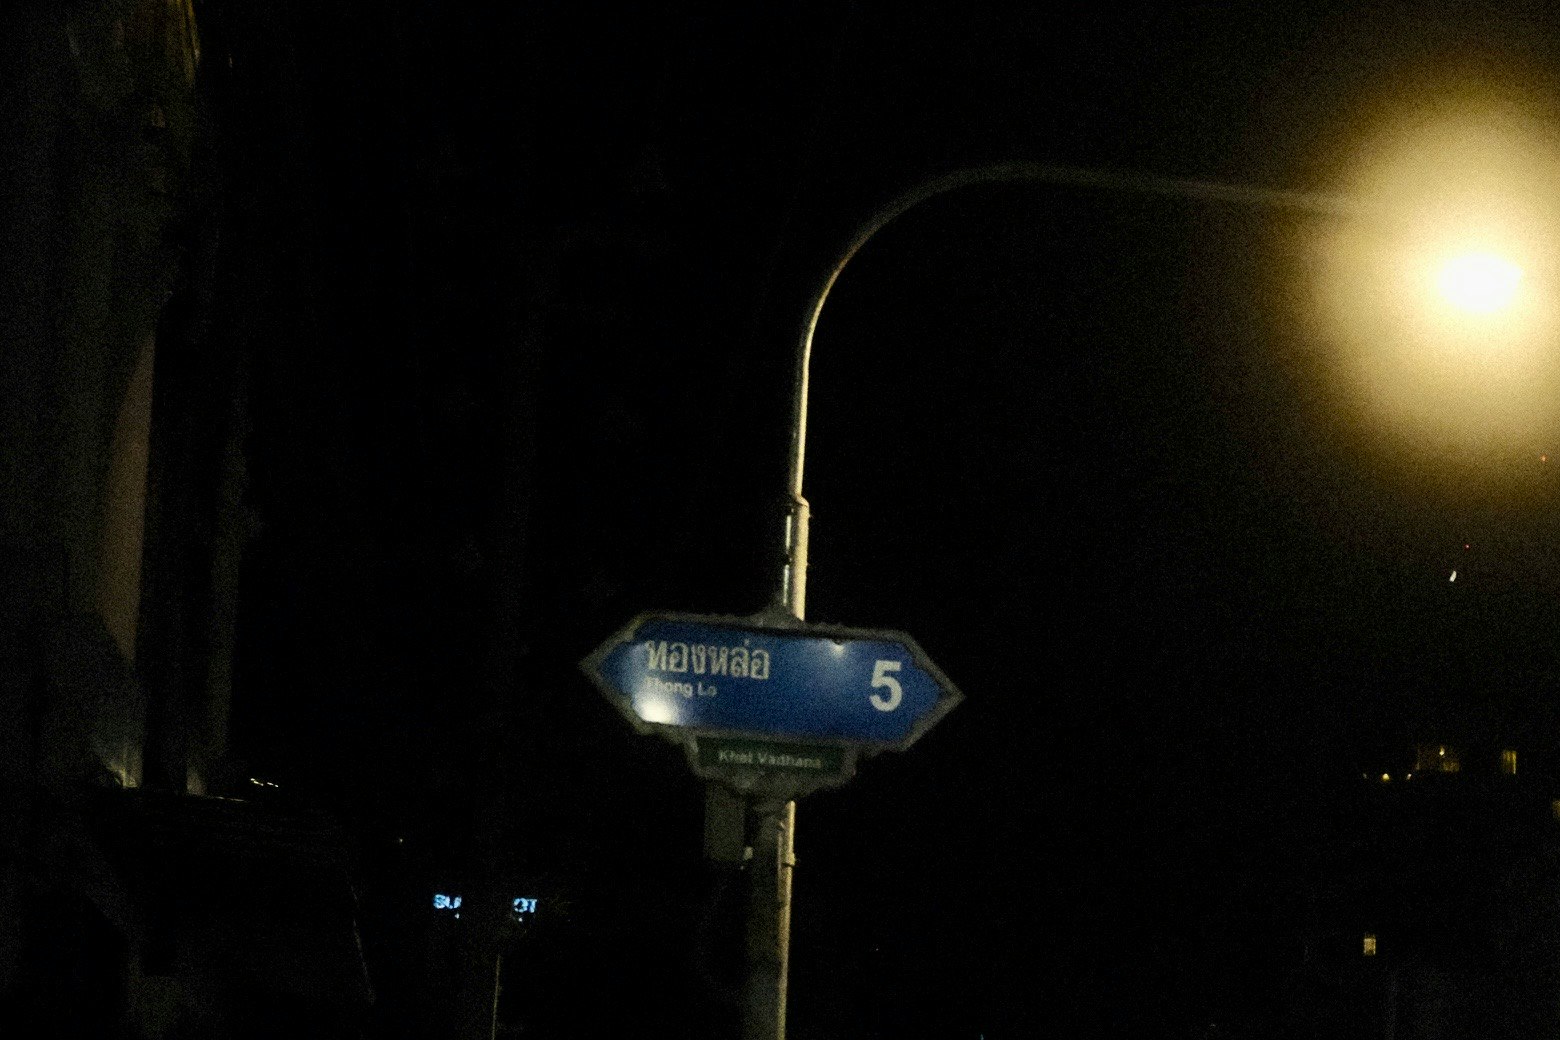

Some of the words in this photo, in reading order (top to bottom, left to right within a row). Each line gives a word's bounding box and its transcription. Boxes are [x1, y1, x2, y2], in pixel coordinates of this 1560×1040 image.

[645, 639, 770, 681] ทองหล่อ
[644, 676, 693, 698] Thong
[697, 681, 718, 697] Lo
[869, 659, 903, 712] 5
